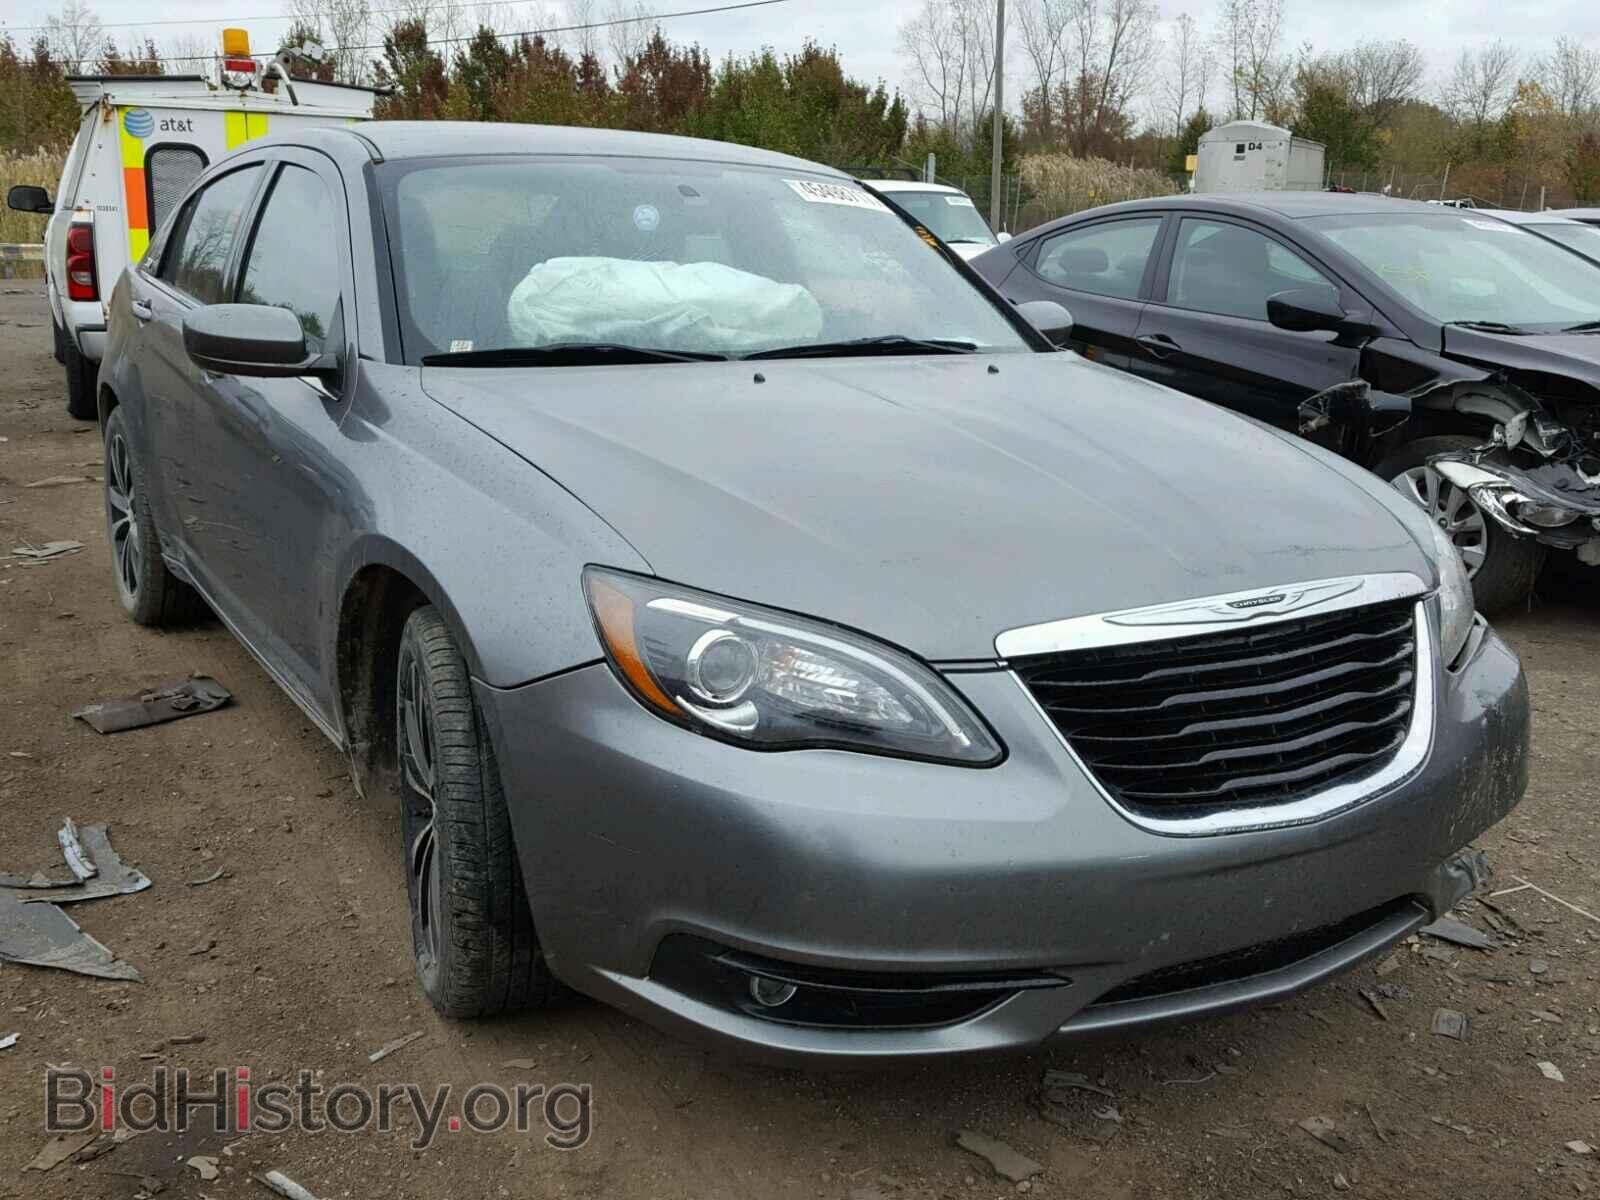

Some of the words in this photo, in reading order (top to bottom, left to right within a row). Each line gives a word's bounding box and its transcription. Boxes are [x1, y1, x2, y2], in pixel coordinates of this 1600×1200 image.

[160, 117, 193, 132] at&t
[1248, 142, 1263, 151] D4
[1232, 596, 1281, 608] CHRYSLER
